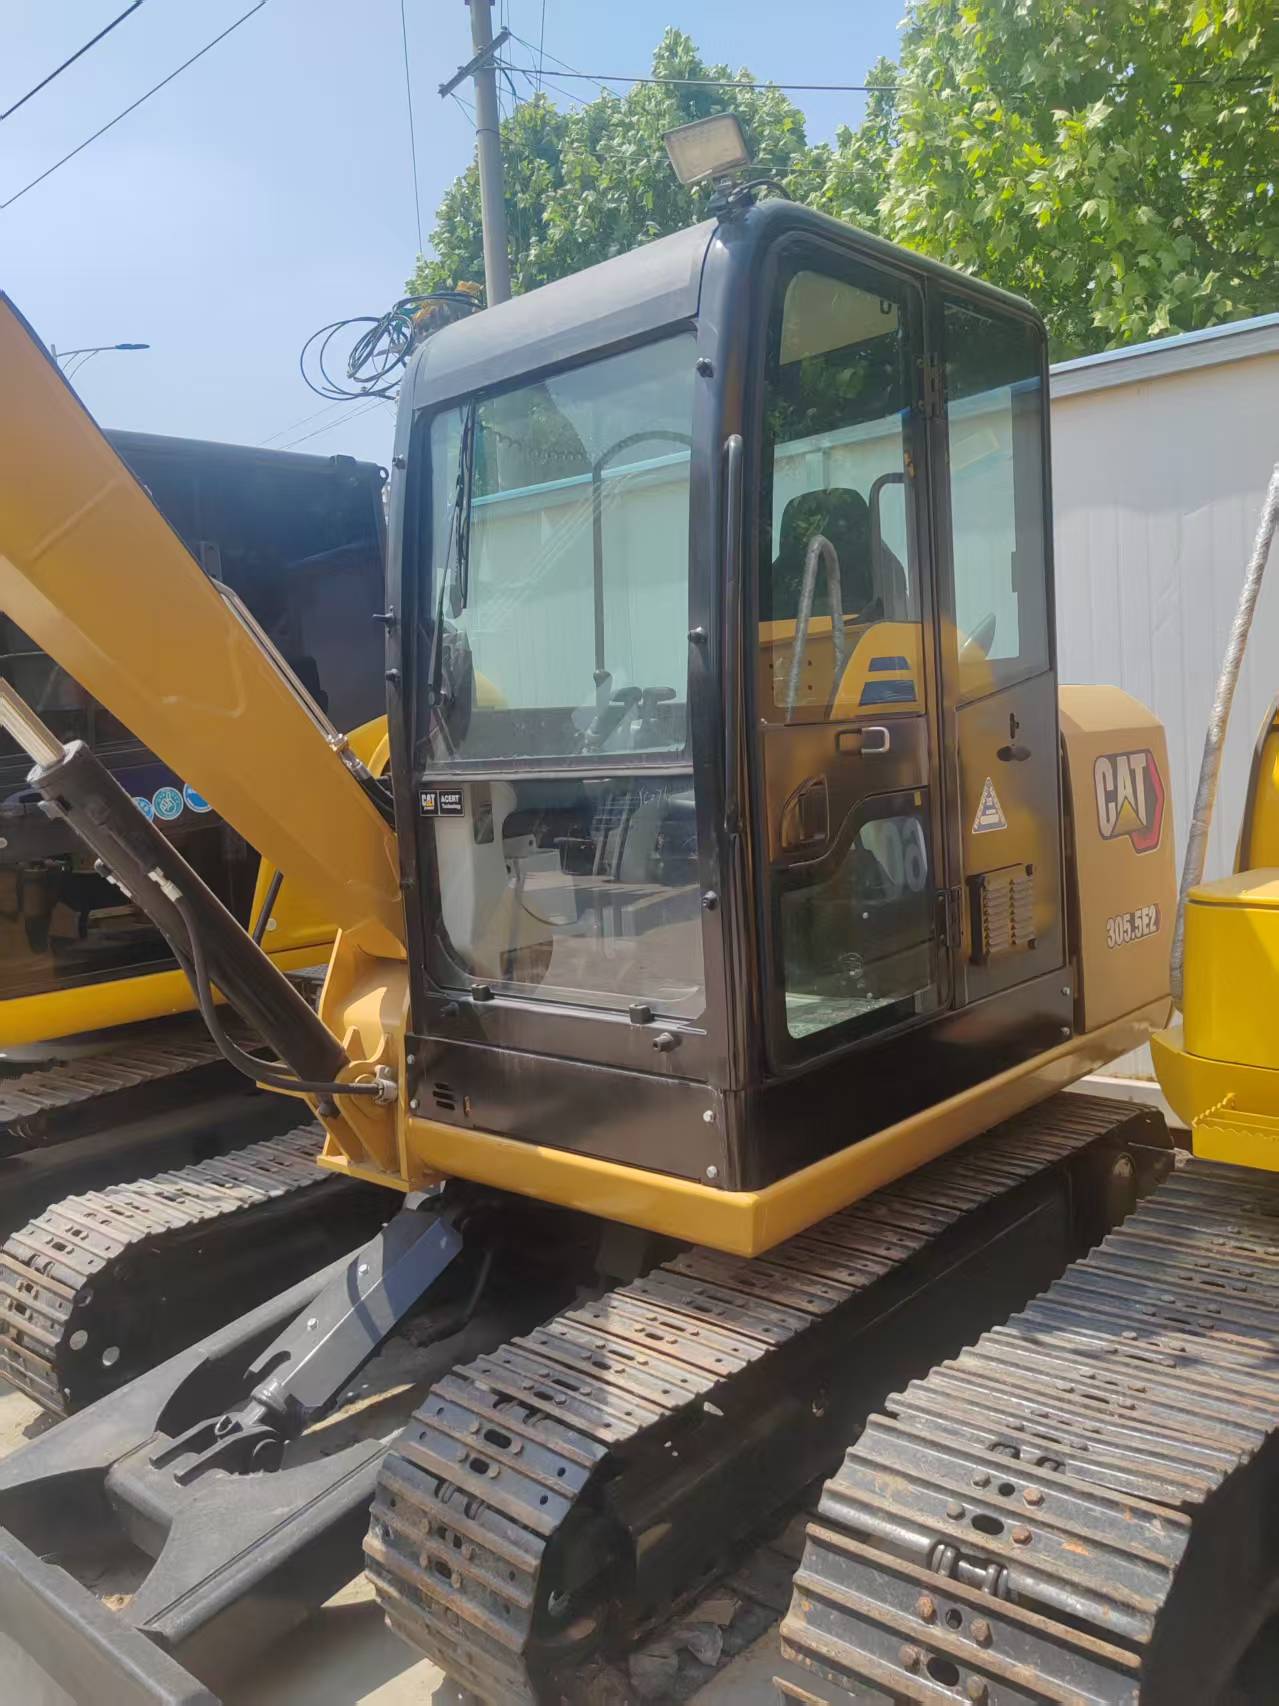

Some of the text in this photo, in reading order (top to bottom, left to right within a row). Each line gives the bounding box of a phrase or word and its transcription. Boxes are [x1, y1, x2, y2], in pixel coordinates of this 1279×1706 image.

[421, 794, 436, 807] CAT
[1094, 753, 1147, 837] CAT
[1107, 904, 1157, 948] 305.5E2
